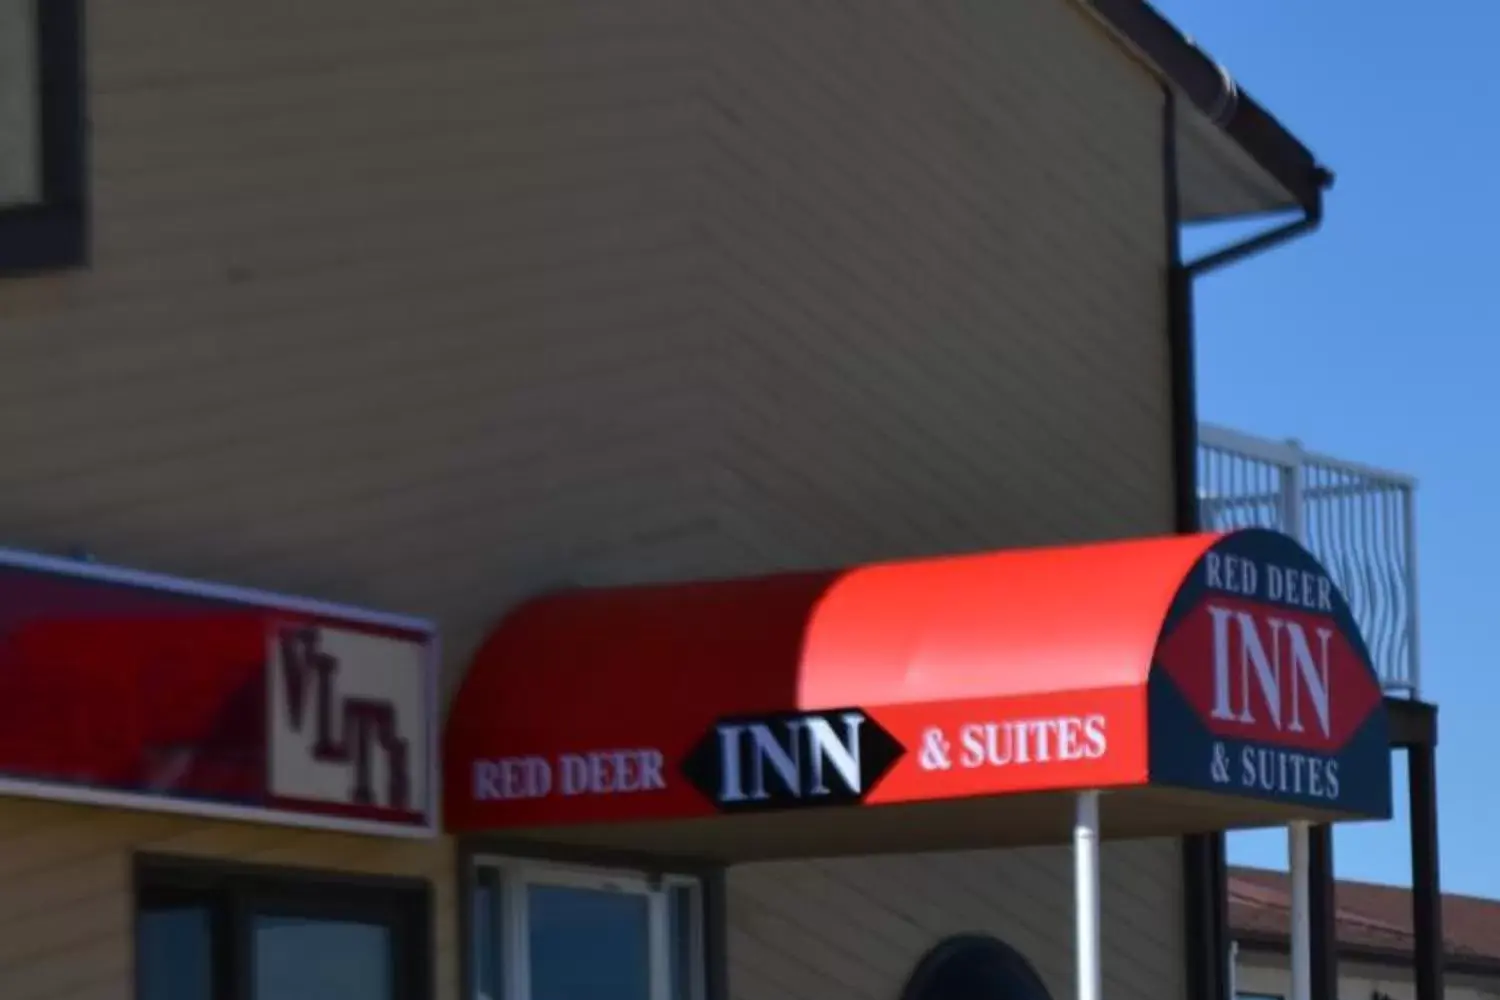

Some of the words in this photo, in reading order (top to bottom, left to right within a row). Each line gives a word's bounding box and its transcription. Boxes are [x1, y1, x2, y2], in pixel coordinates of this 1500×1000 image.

[1205, 552, 1258, 594] RED
[1267, 564, 1333, 611] DEER
[1207, 604, 1333, 739] INN
[472, 756, 552, 801] RED
[559, 748, 667, 796] DEER
[716, 713, 865, 801] INN
[918, 726, 952, 771] &
[961, 714, 1107, 768] SUITES
[1210, 741, 1231, 784] &
[1241, 745, 1340, 800] SUITES
